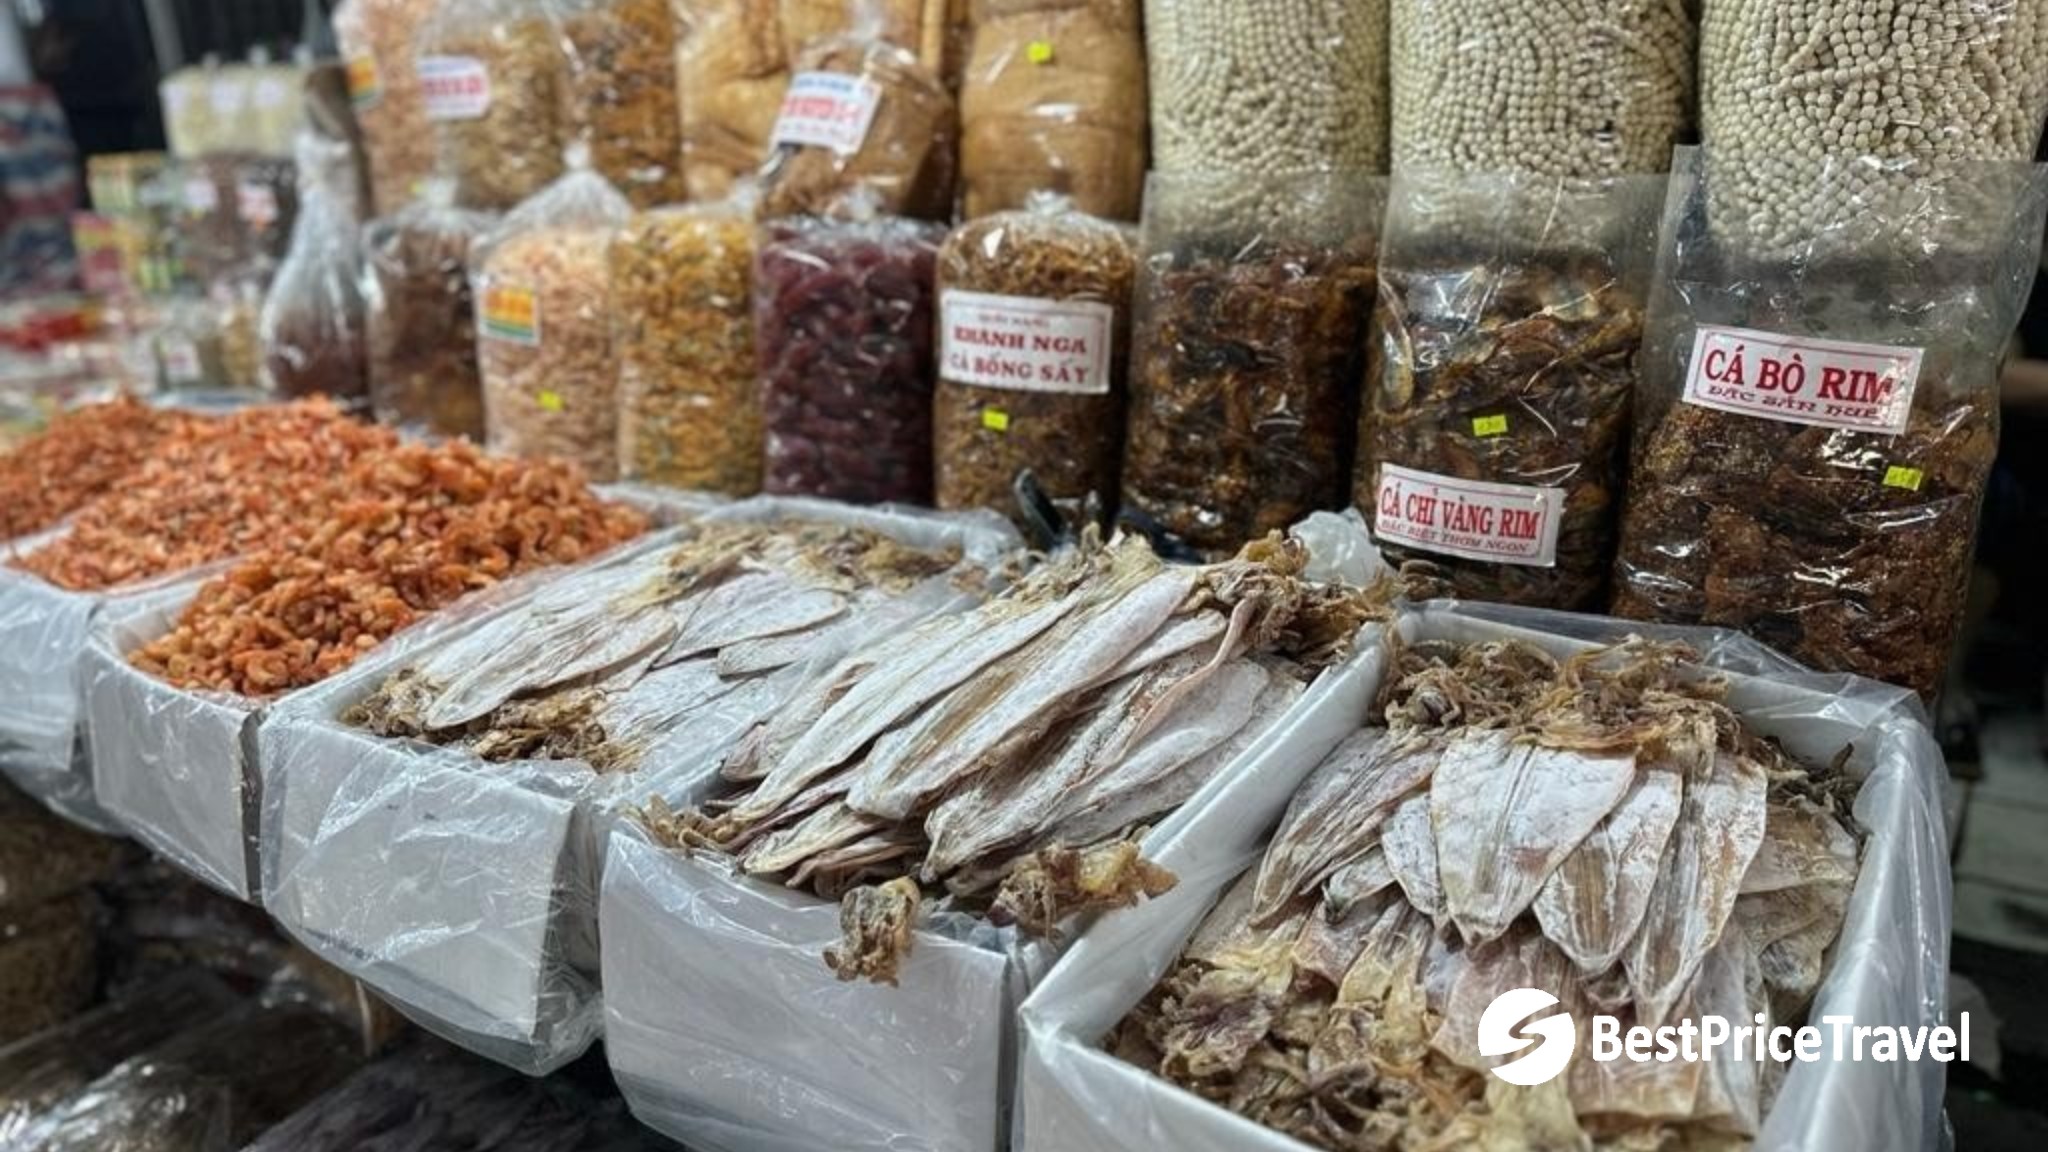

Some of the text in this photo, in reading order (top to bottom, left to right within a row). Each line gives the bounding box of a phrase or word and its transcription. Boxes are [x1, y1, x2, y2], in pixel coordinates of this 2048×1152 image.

[1033, 335, 1088, 354] NGA
[1705, 344, 1894, 405] CÁ BÒ RIM
[1381, 481, 1541, 540] CÁ CHỈ VÀNG RIM
